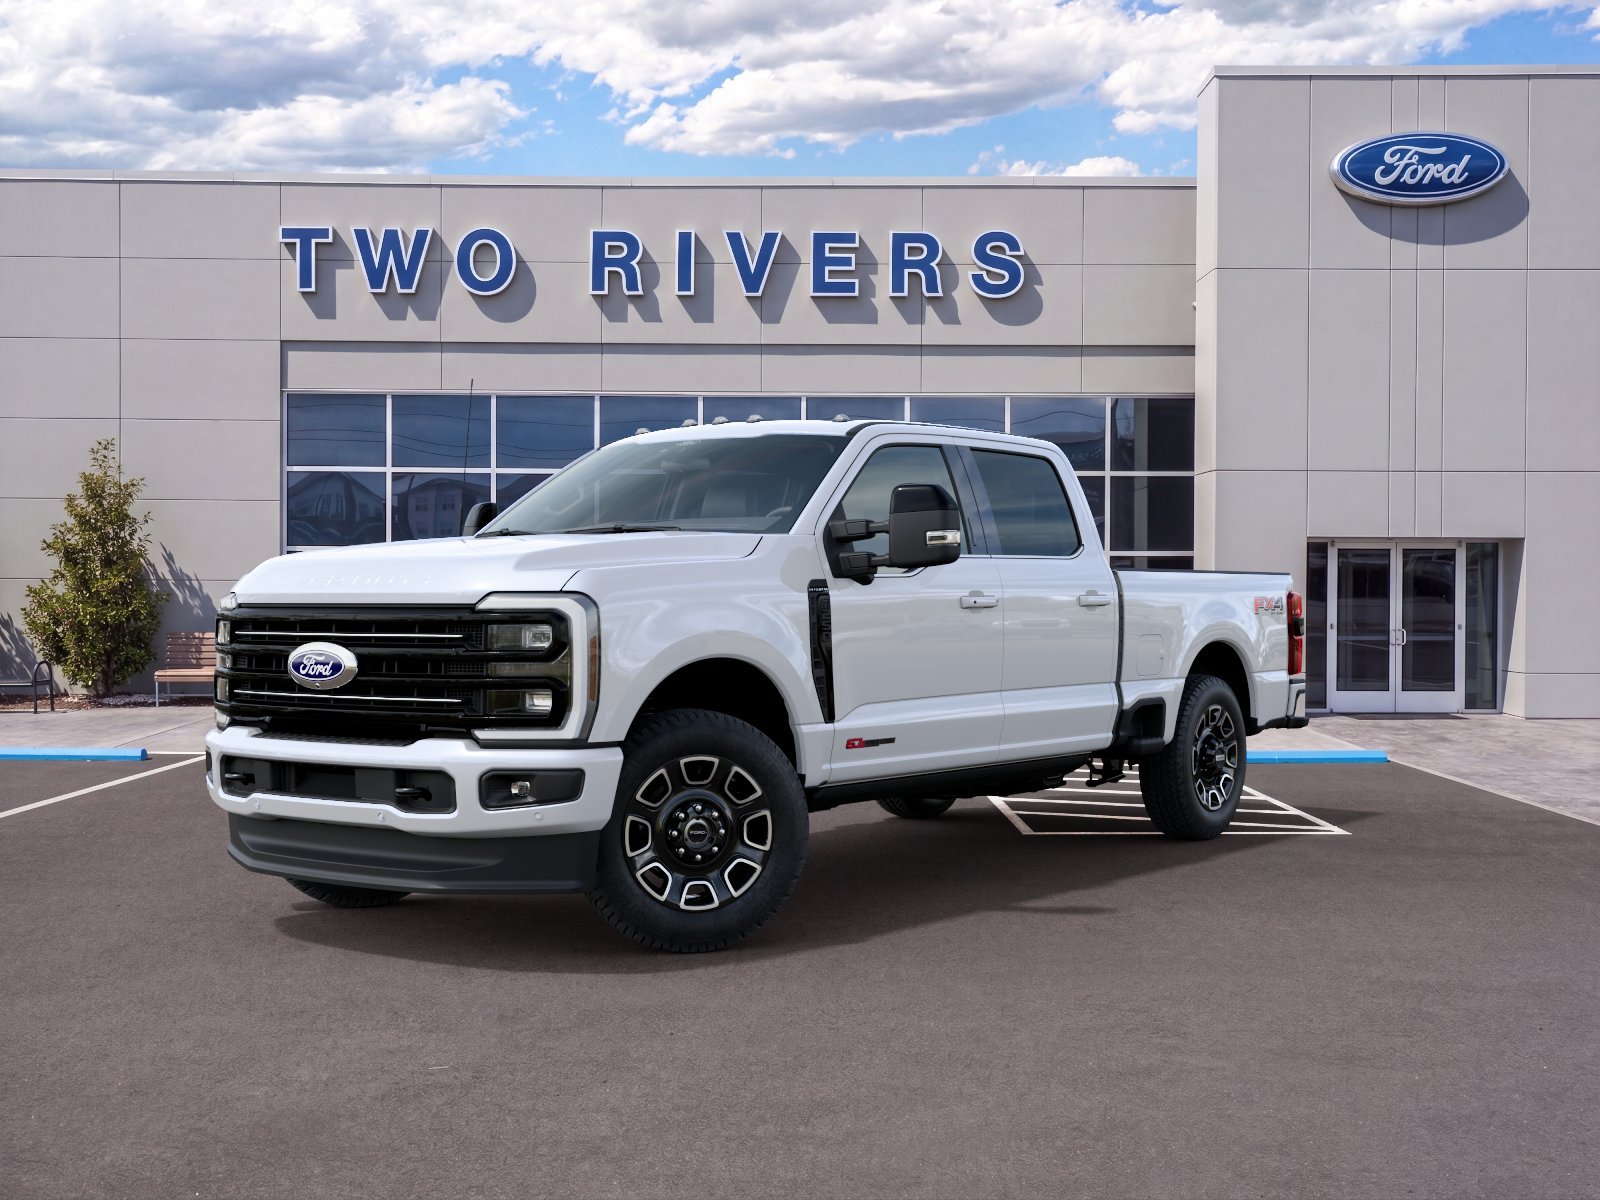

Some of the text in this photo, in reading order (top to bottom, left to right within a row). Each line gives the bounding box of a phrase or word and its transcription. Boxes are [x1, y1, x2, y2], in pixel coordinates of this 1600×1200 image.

[1374, 145, 1472, 186] Ford
[279, 226, 1026, 299] TWO RIVERS
[1253, 597, 1284, 615] FX4
[299, 654, 334, 676] Ford
